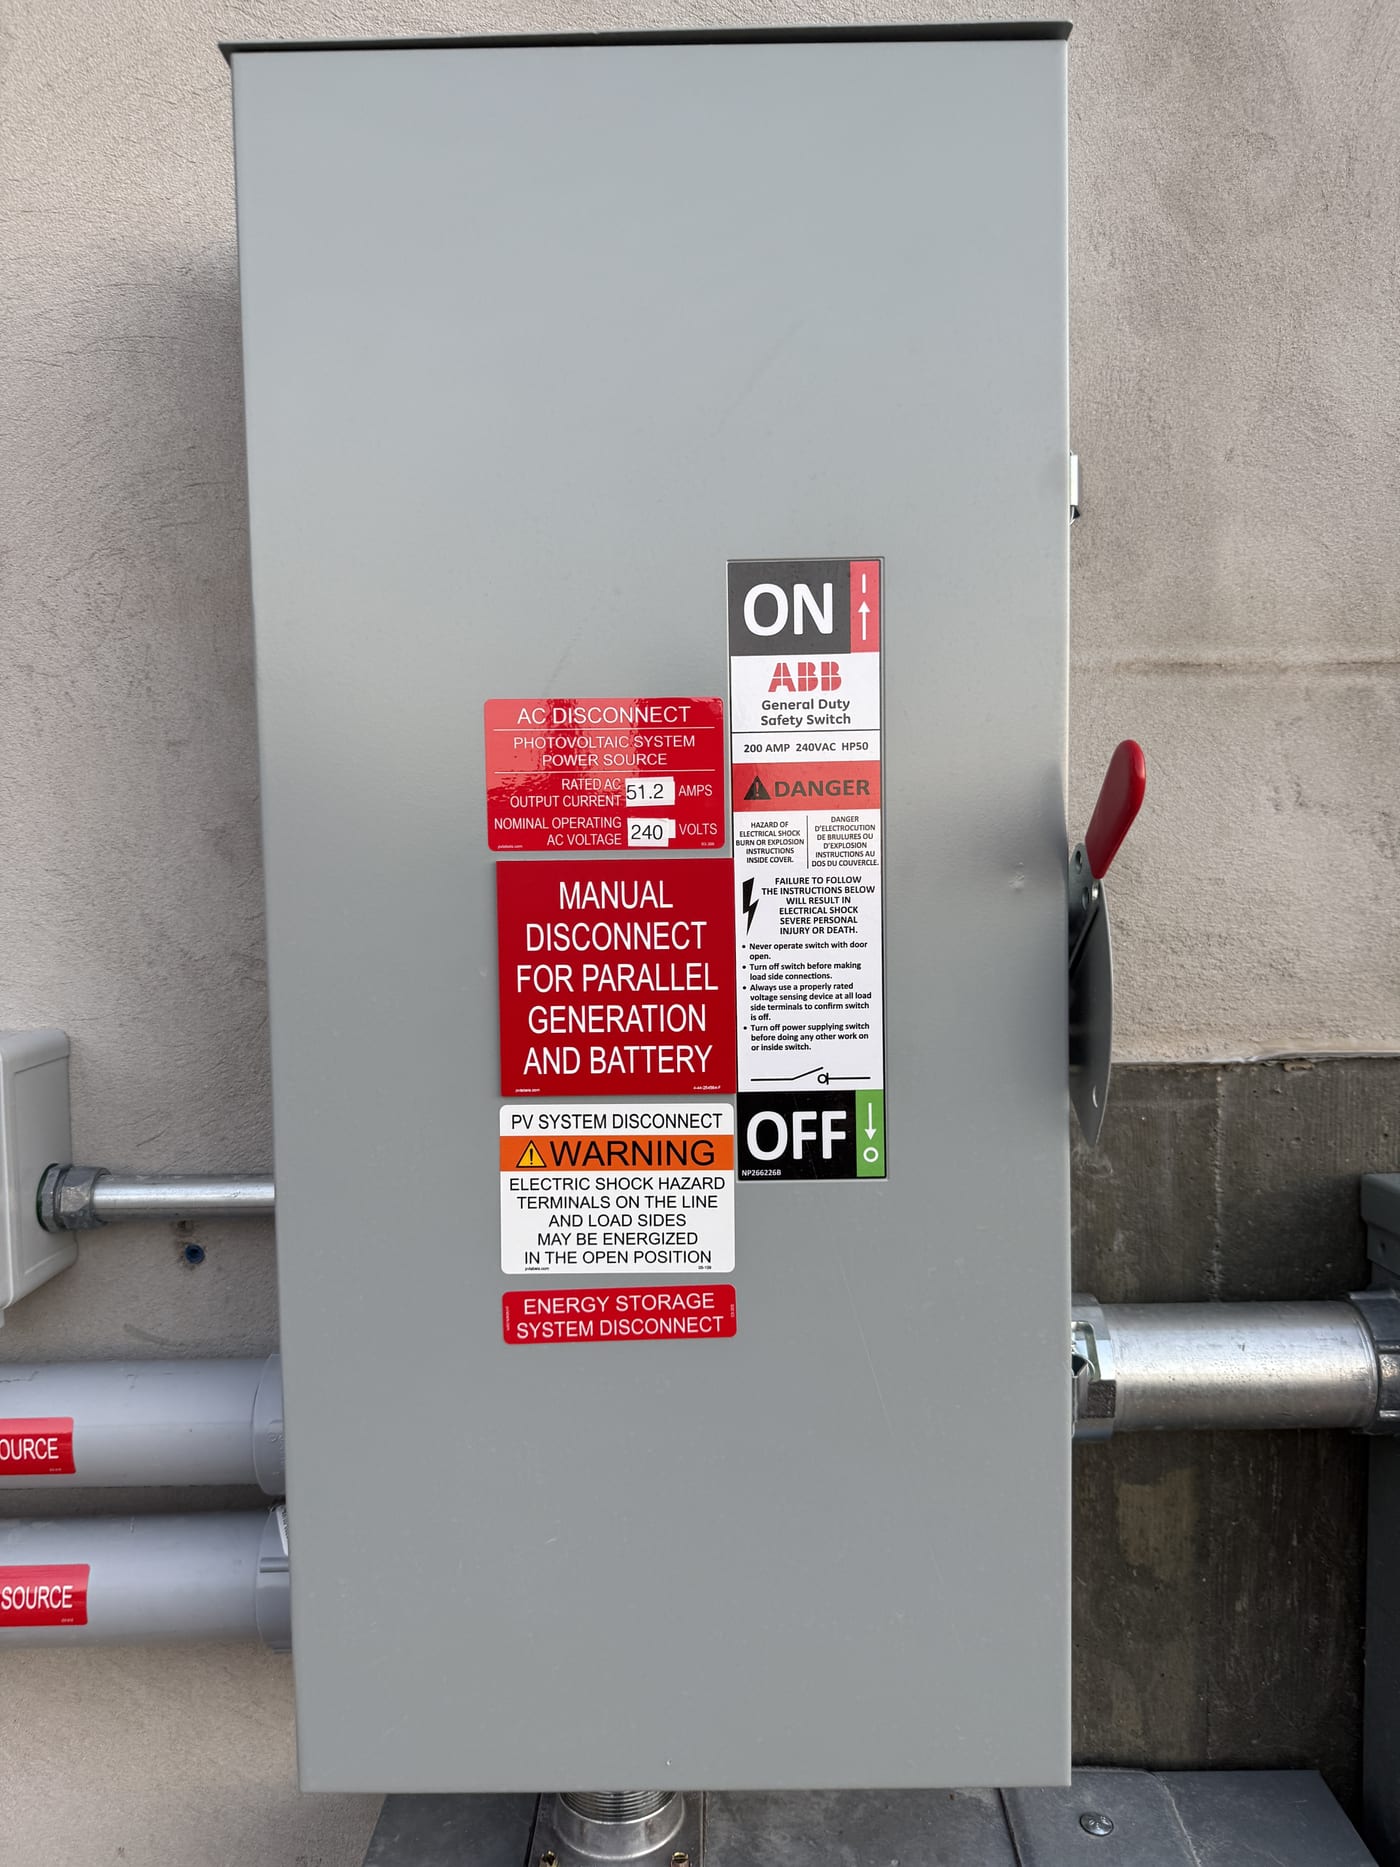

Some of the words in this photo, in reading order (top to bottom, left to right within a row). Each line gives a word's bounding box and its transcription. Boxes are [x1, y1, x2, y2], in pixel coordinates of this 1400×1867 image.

[744, 583, 833, 636] ON
[768, 662, 842, 692] ABB
[762, 699, 814, 710] General
[819, 699, 850, 711] Duty
[517, 708, 545, 724] AC
[553, 706, 691, 723] DISCONNECT
[761, 715, 802, 727] Safety
[806, 714, 851, 725] Switch
[514, 736, 629, 749] PHOTOVOLTAIC
[634, 735, 695, 748] SYSTEM
[744, 744, 762, 752] 200
[766, 744, 790, 752] AMP
[796, 743, 836, 751] 240VAC
[842, 742, 868, 751] HP50
[543, 754, 598, 766] POWER
[603, 753, 667, 766] SOURCE
[562, 778, 601, 790] RATED
[604, 778, 620, 789] AC
[678, 785, 712, 796] AMPS
[774, 780, 870, 797] DANGER
[627, 784, 664, 800] 51.2
[510, 796, 558, 808] OUTPUT
[563, 795, 621, 807] CURRENT
[494, 817, 548, 829] NOMINAL
[552, 817, 621, 829] OPERATING
[679, 823, 717, 834] VOLTS
[547, 834, 564, 845] AC
[567, 834, 621, 845] VOLTAGE
[631, 825, 663, 840] 240
[775, 877, 809, 885] FAILURE
[560, 880, 673, 910] MANUAL
[786, 897, 806, 905] WILL
[780, 917, 811, 925] SEVERE
[813, 916, 858, 924] PERSONAL
[526, 921, 707, 951] DISCONNECT
[780, 927, 810, 935] INJURY
[827, 926, 858, 934] DEATH.
[774, 942, 803, 951] operate
[750, 953, 771, 961] open.
[834, 962, 861, 970] making
[517, 964, 574, 993] FOR
[583, 962, 719, 992] PARALLEL
[799, 983, 831, 991] properly
[750, 994, 778, 1002] voltage
[528, 1003, 706, 1034] GENERATION
[782, 1024, 806, 1032] power
[808, 1023, 843, 1031] supplying
[523, 1046, 581, 1075] AND
[590, 1044, 713, 1074] BATTERY
[512, 1114, 533, 1129] PV
[538, 1114, 607, 1129] SYSTEM
[612, 1113, 723, 1129] DISCONNECT
[747, 1111, 846, 1160] OFF
[550, 1140, 715, 1166] WARNING
[510, 1177, 590, 1191] ELECTRIC
[595, 1177, 653, 1190] SHOCK
[659, 1177, 725, 1190] HAZARD
[517, 1196, 611, 1209] TERMINALS
[615, 1196, 639, 1209] ON
[645, 1195, 677, 1209] THE
[682, 1195, 718, 1208] LINE
[549, 1215, 583, 1228] AND
[588, 1215, 632, 1227] LOAD
[637, 1214, 686, 1227] SIDES
[537, 1233, 571, 1246] MAY
[576, 1233, 598, 1246] BE
[603, 1232, 698, 1245] ENERGIZED
[525, 1252, 540, 1264] IN
[545, 1252, 577, 1264] THE
[582, 1251, 628, 1264] OPEN
[634, 1250, 712, 1264] POSITION
[524, 1296, 610, 1315] ENERGY
[615, 1293, 715, 1311] STORAGE
[517, 1321, 594, 1340] SYSTEM
[600, 1316, 723, 1336] DISCONNECT
[1, 1585, 74, 1610] SOURCE
